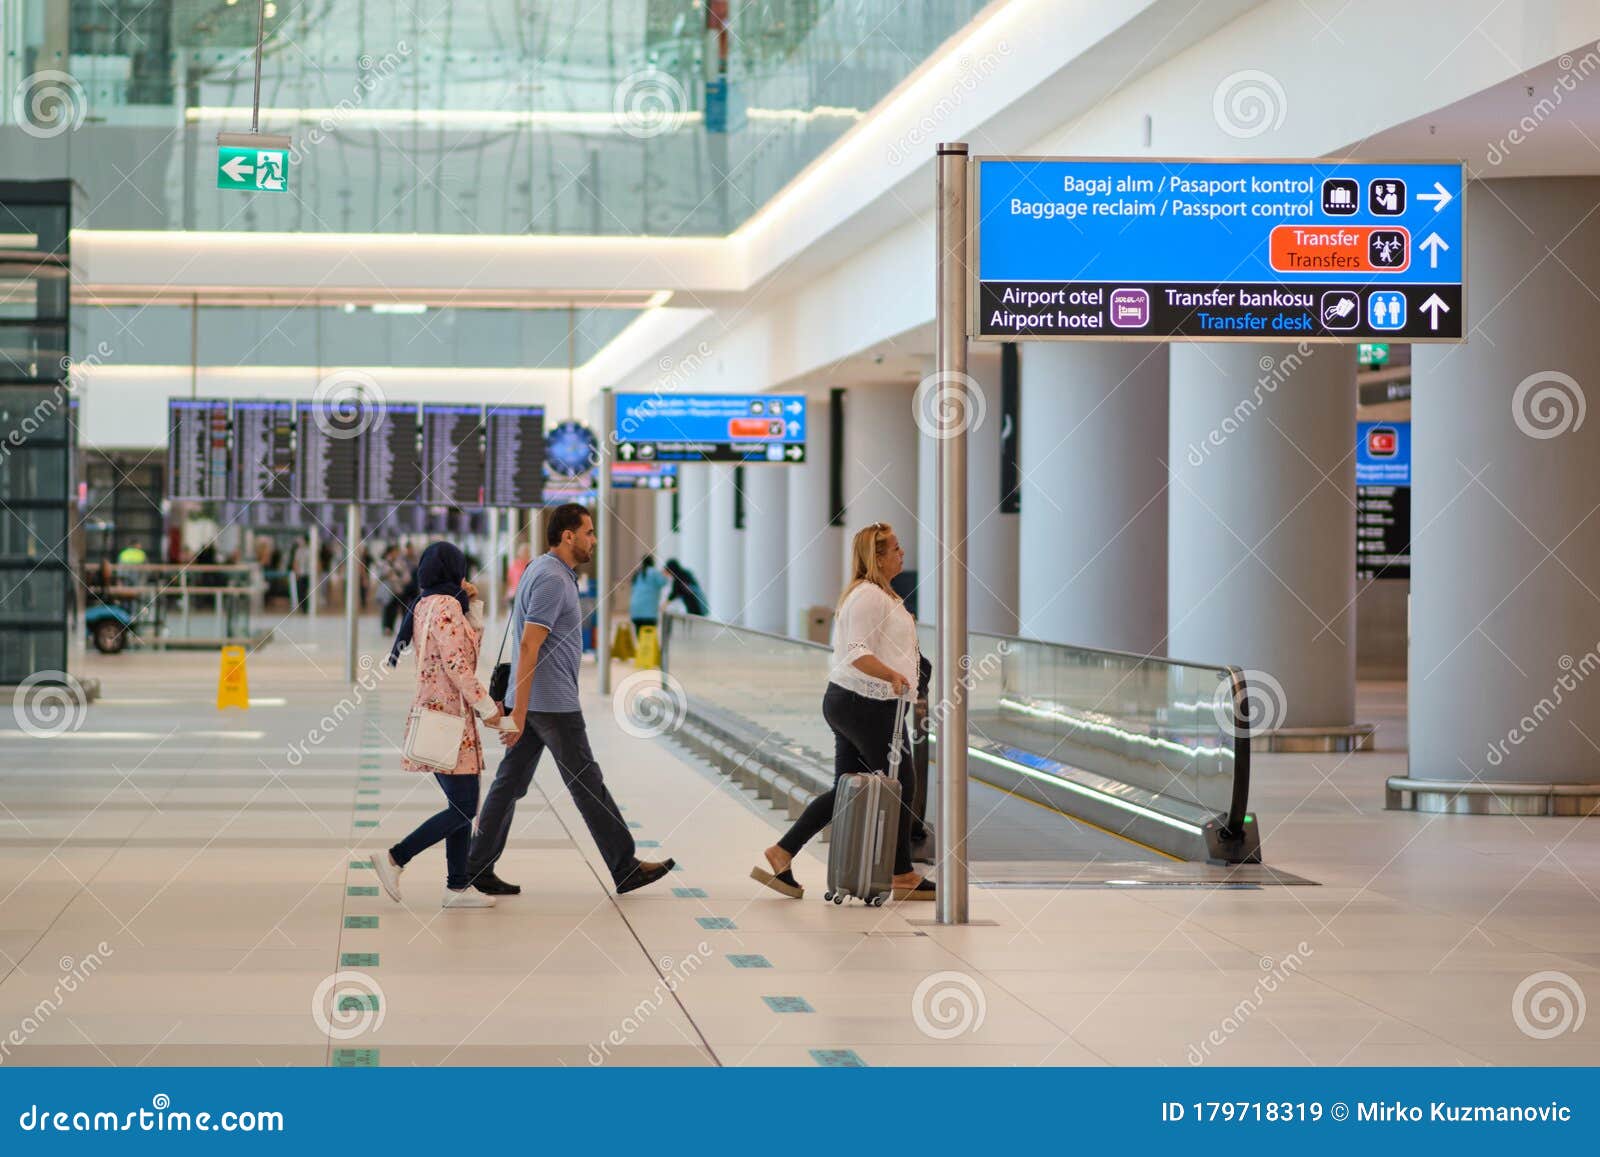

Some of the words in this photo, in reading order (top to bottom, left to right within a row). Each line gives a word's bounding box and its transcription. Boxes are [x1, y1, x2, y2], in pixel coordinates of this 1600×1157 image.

[1063, 175, 1112, 196] Bagaj
[1116, 175, 1154, 193] alım
[1157, 176, 1166, 193] /
[1170, 175, 1247, 197] Pasaport
[1251, 175, 1314, 193] kontrol
[1011, 199, 1088, 220] Baggage
[1092, 198, 1156, 216] reclaim
[1160, 199, 1168, 216] /
[1172, 199, 1247, 221] Passport
[1251, 199, 1313, 217] control
[1292, 230, 1361, 247] Transfer
[1287, 252, 1361, 268] Transfers
[1002, 288, 1066, 308] Airport
[1070, 288, 1103, 305] otel
[1165, 289, 1236, 306] Transfer
[1240, 289, 1314, 307] bankosu
[991, 311, 1054, 331] Airport
[1058, 311, 1103, 328] hotel
[1198, 313, 1268, 330] Transfer
[1272, 313, 1314, 331] desk
